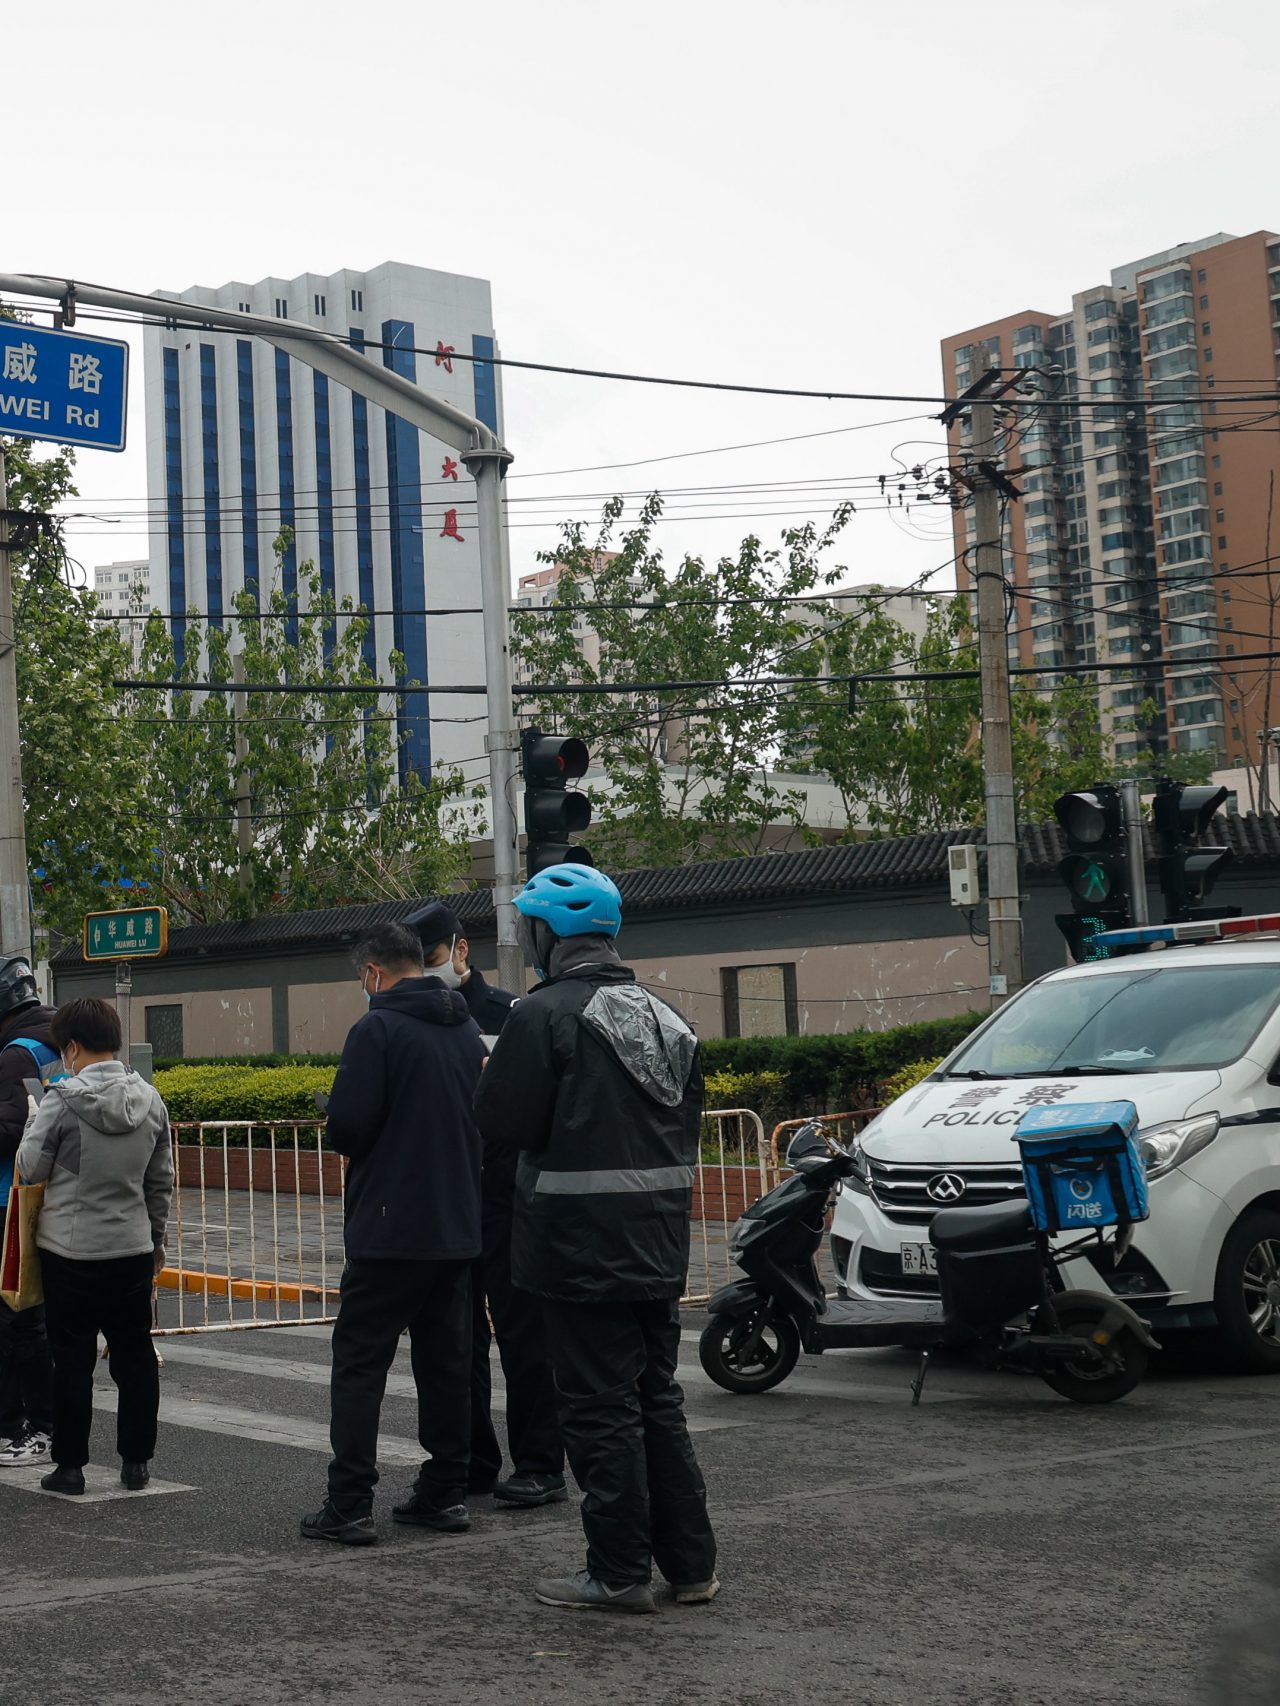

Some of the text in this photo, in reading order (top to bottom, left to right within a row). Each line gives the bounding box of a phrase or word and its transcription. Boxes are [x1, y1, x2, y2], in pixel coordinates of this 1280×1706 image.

[66, 404, 100, 428] Rd
[108, 915, 154, 938] 华威路
[114, 938, 147, 950] HUAWEI LU
[947, 1083, 1079, 1109] 警察
[1067, 1202, 1102, 1220] 闪送
